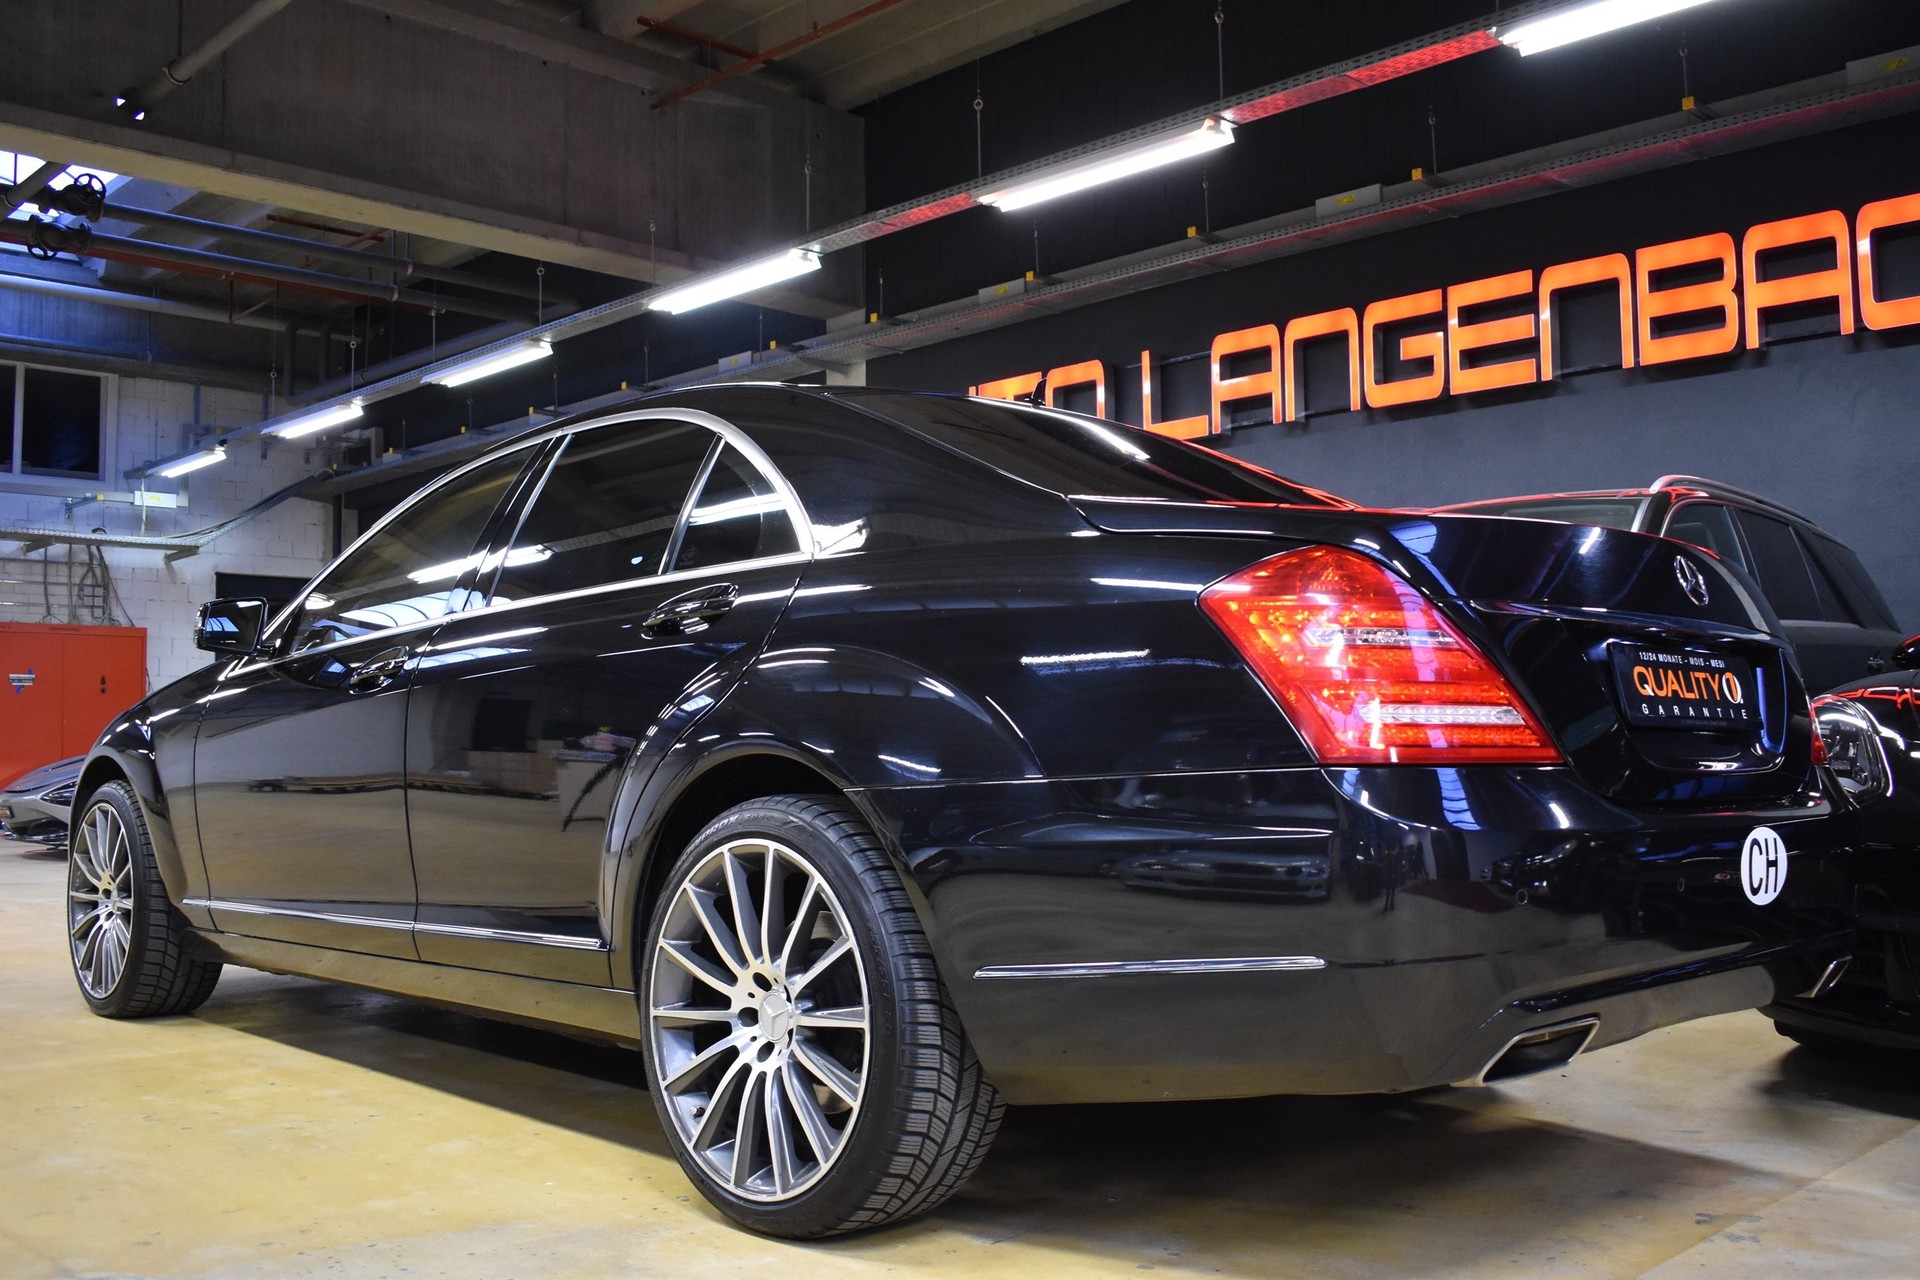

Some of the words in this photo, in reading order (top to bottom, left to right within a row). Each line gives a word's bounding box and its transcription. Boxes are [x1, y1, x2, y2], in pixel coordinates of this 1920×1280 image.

[1639, 651, 1657, 661] 12/24
[1657, 653, 1683, 664] MONATE
[1689, 656, 1705, 667] MOIS
[1641, 703, 1748, 719] GARANTIE
[1748, 837, 1779, 897] CH
